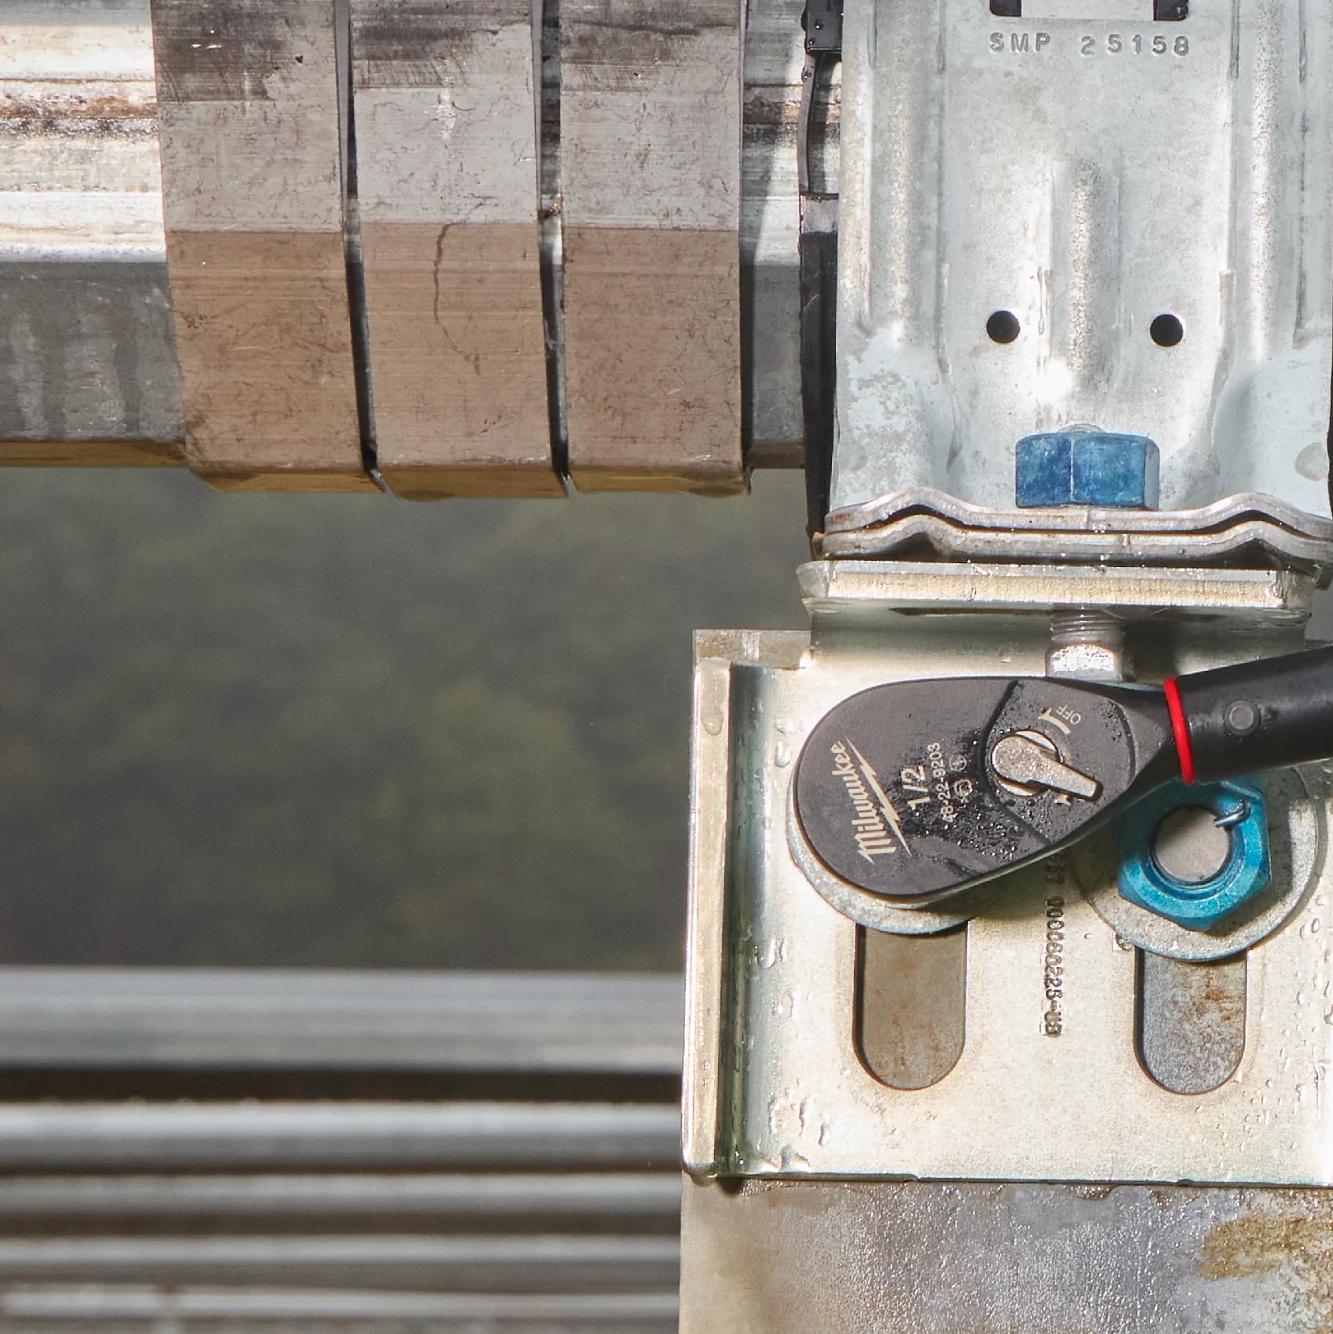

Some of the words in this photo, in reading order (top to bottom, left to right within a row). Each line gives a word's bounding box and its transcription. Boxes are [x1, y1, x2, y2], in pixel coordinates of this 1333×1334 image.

[989, 32, 1051, 53] SMP
[1080, 33, 1190, 56] 25158
[1055, 704, 1082, 726] OFF
[830, 740, 897, 864] Milwaukee
[901, 764, 930, 810] 1/2
[928, 742, 953, 823] 48-22-9203
